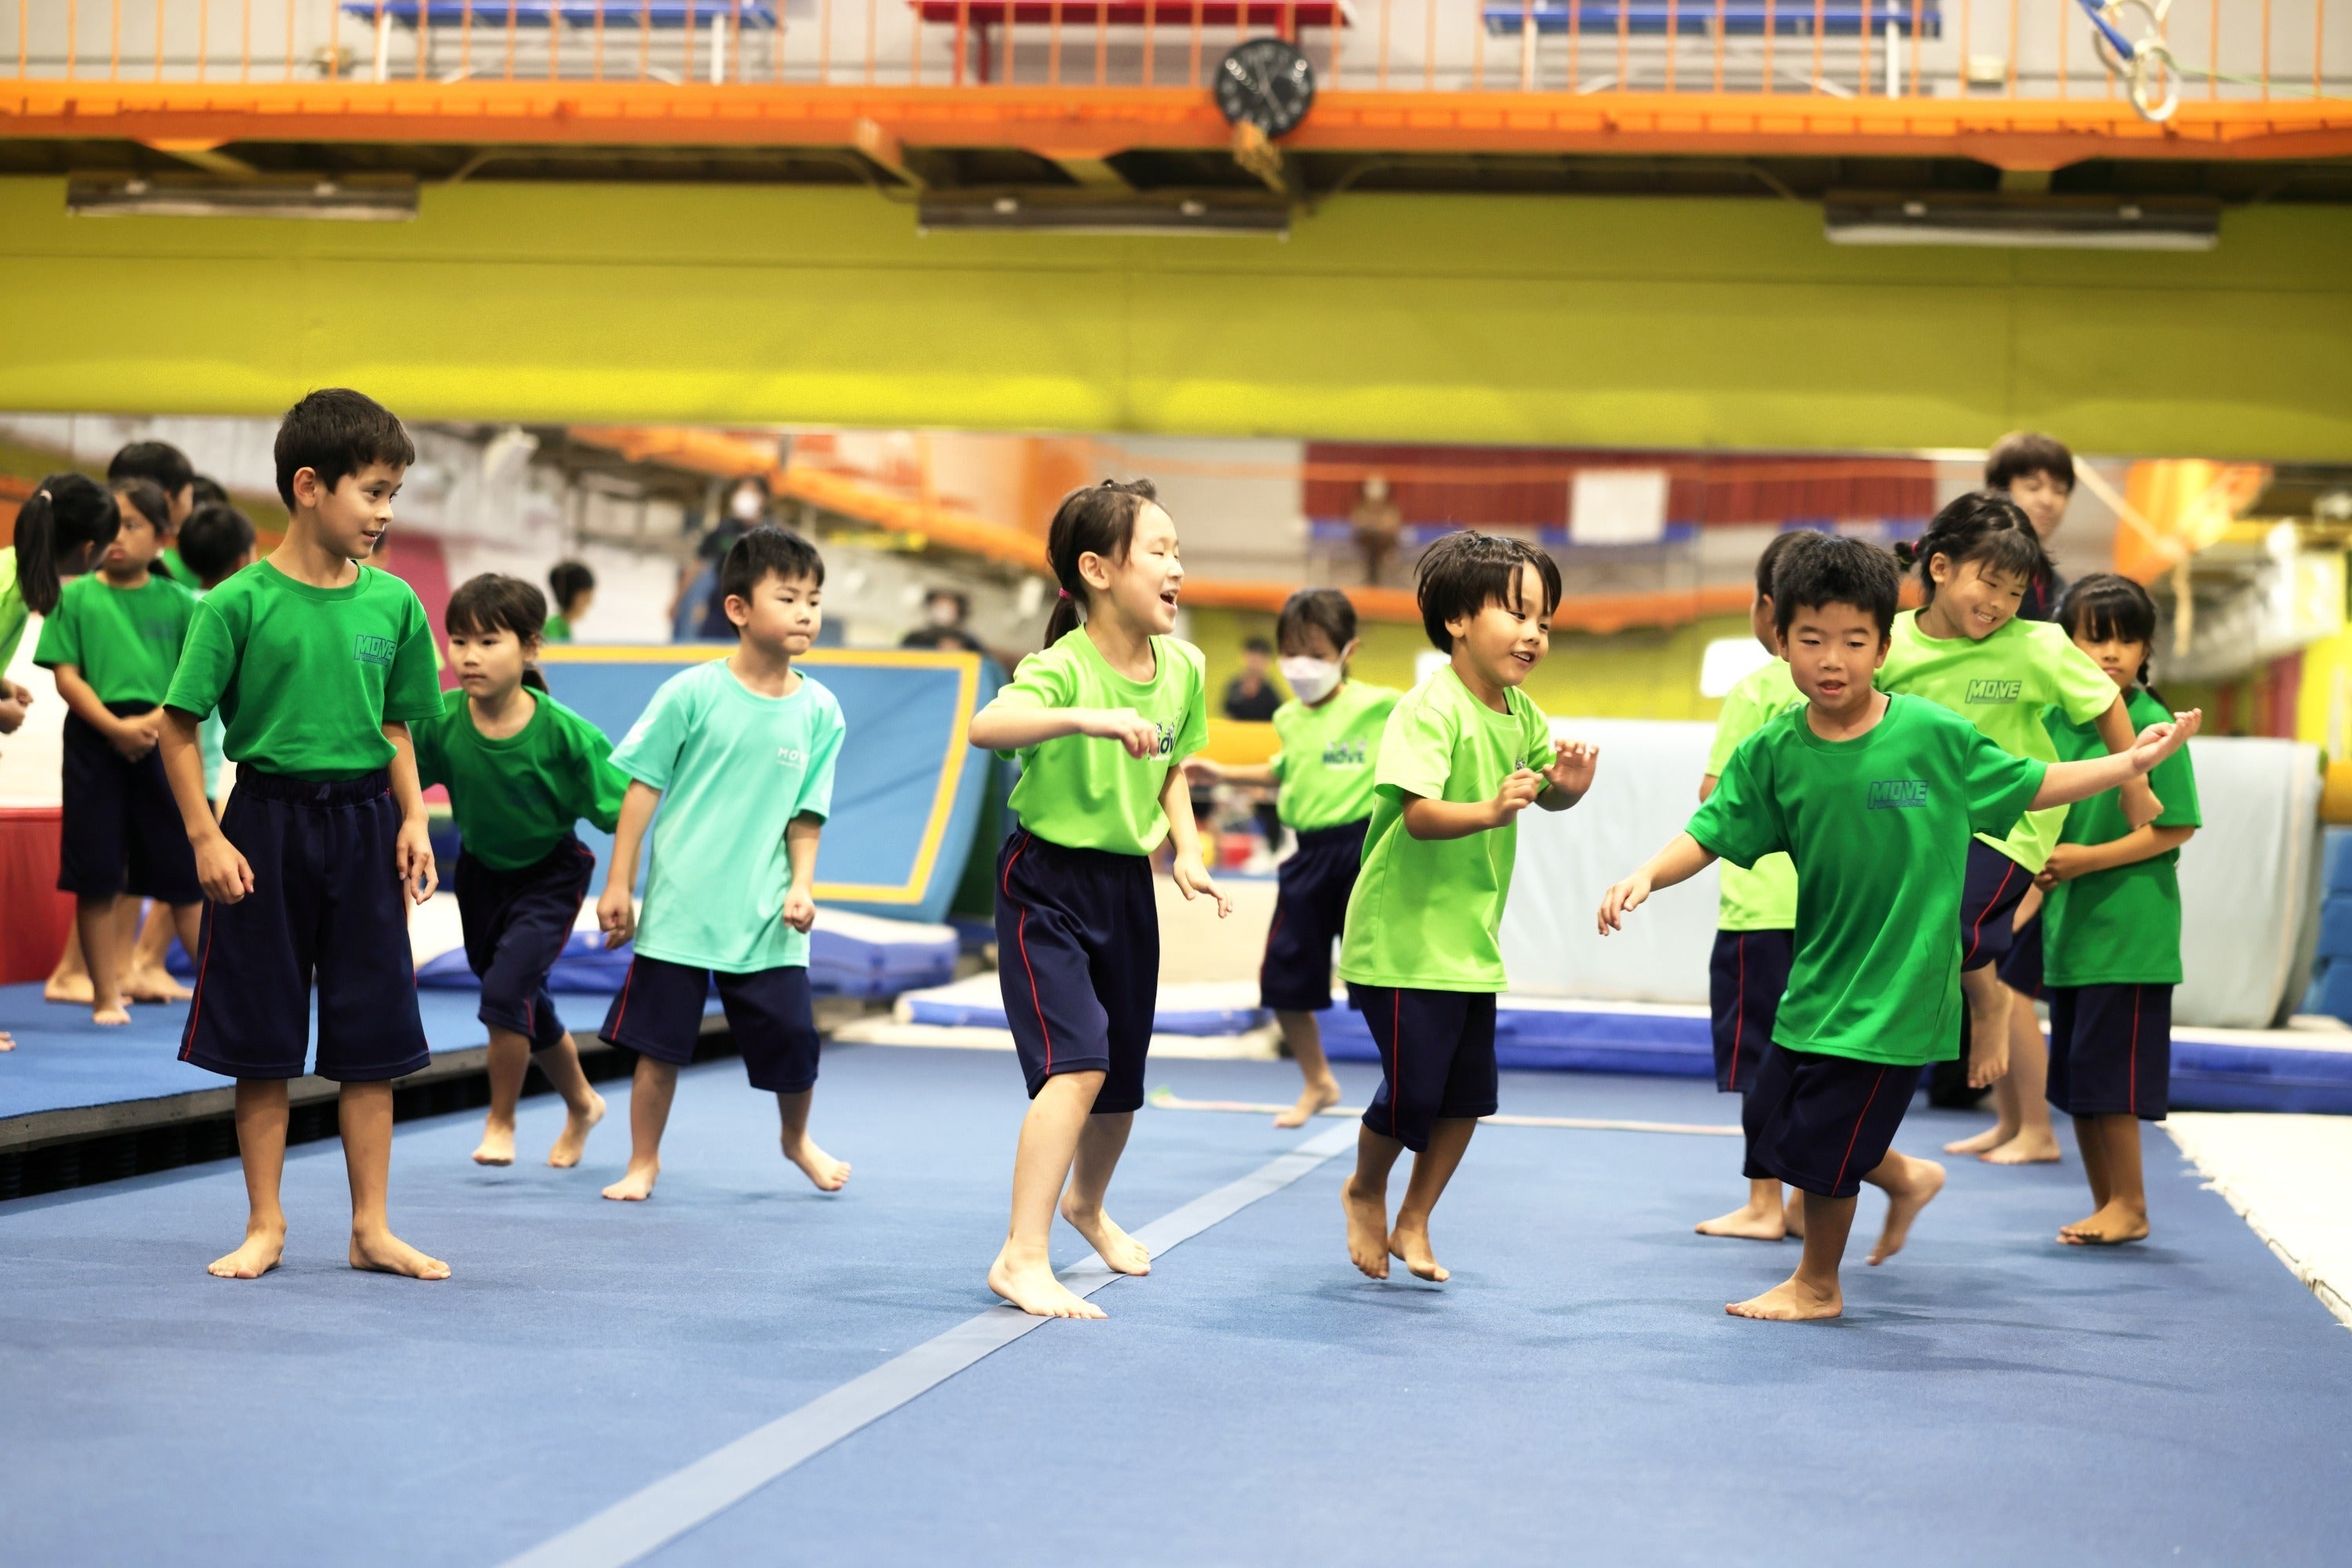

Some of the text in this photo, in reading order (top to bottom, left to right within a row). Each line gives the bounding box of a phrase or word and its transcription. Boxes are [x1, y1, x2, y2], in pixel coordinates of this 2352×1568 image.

[354, 634, 397, 661] MOVE
[1965, 679, 2022, 703] MOVE
[1867, 779, 1929, 809] MOVE
